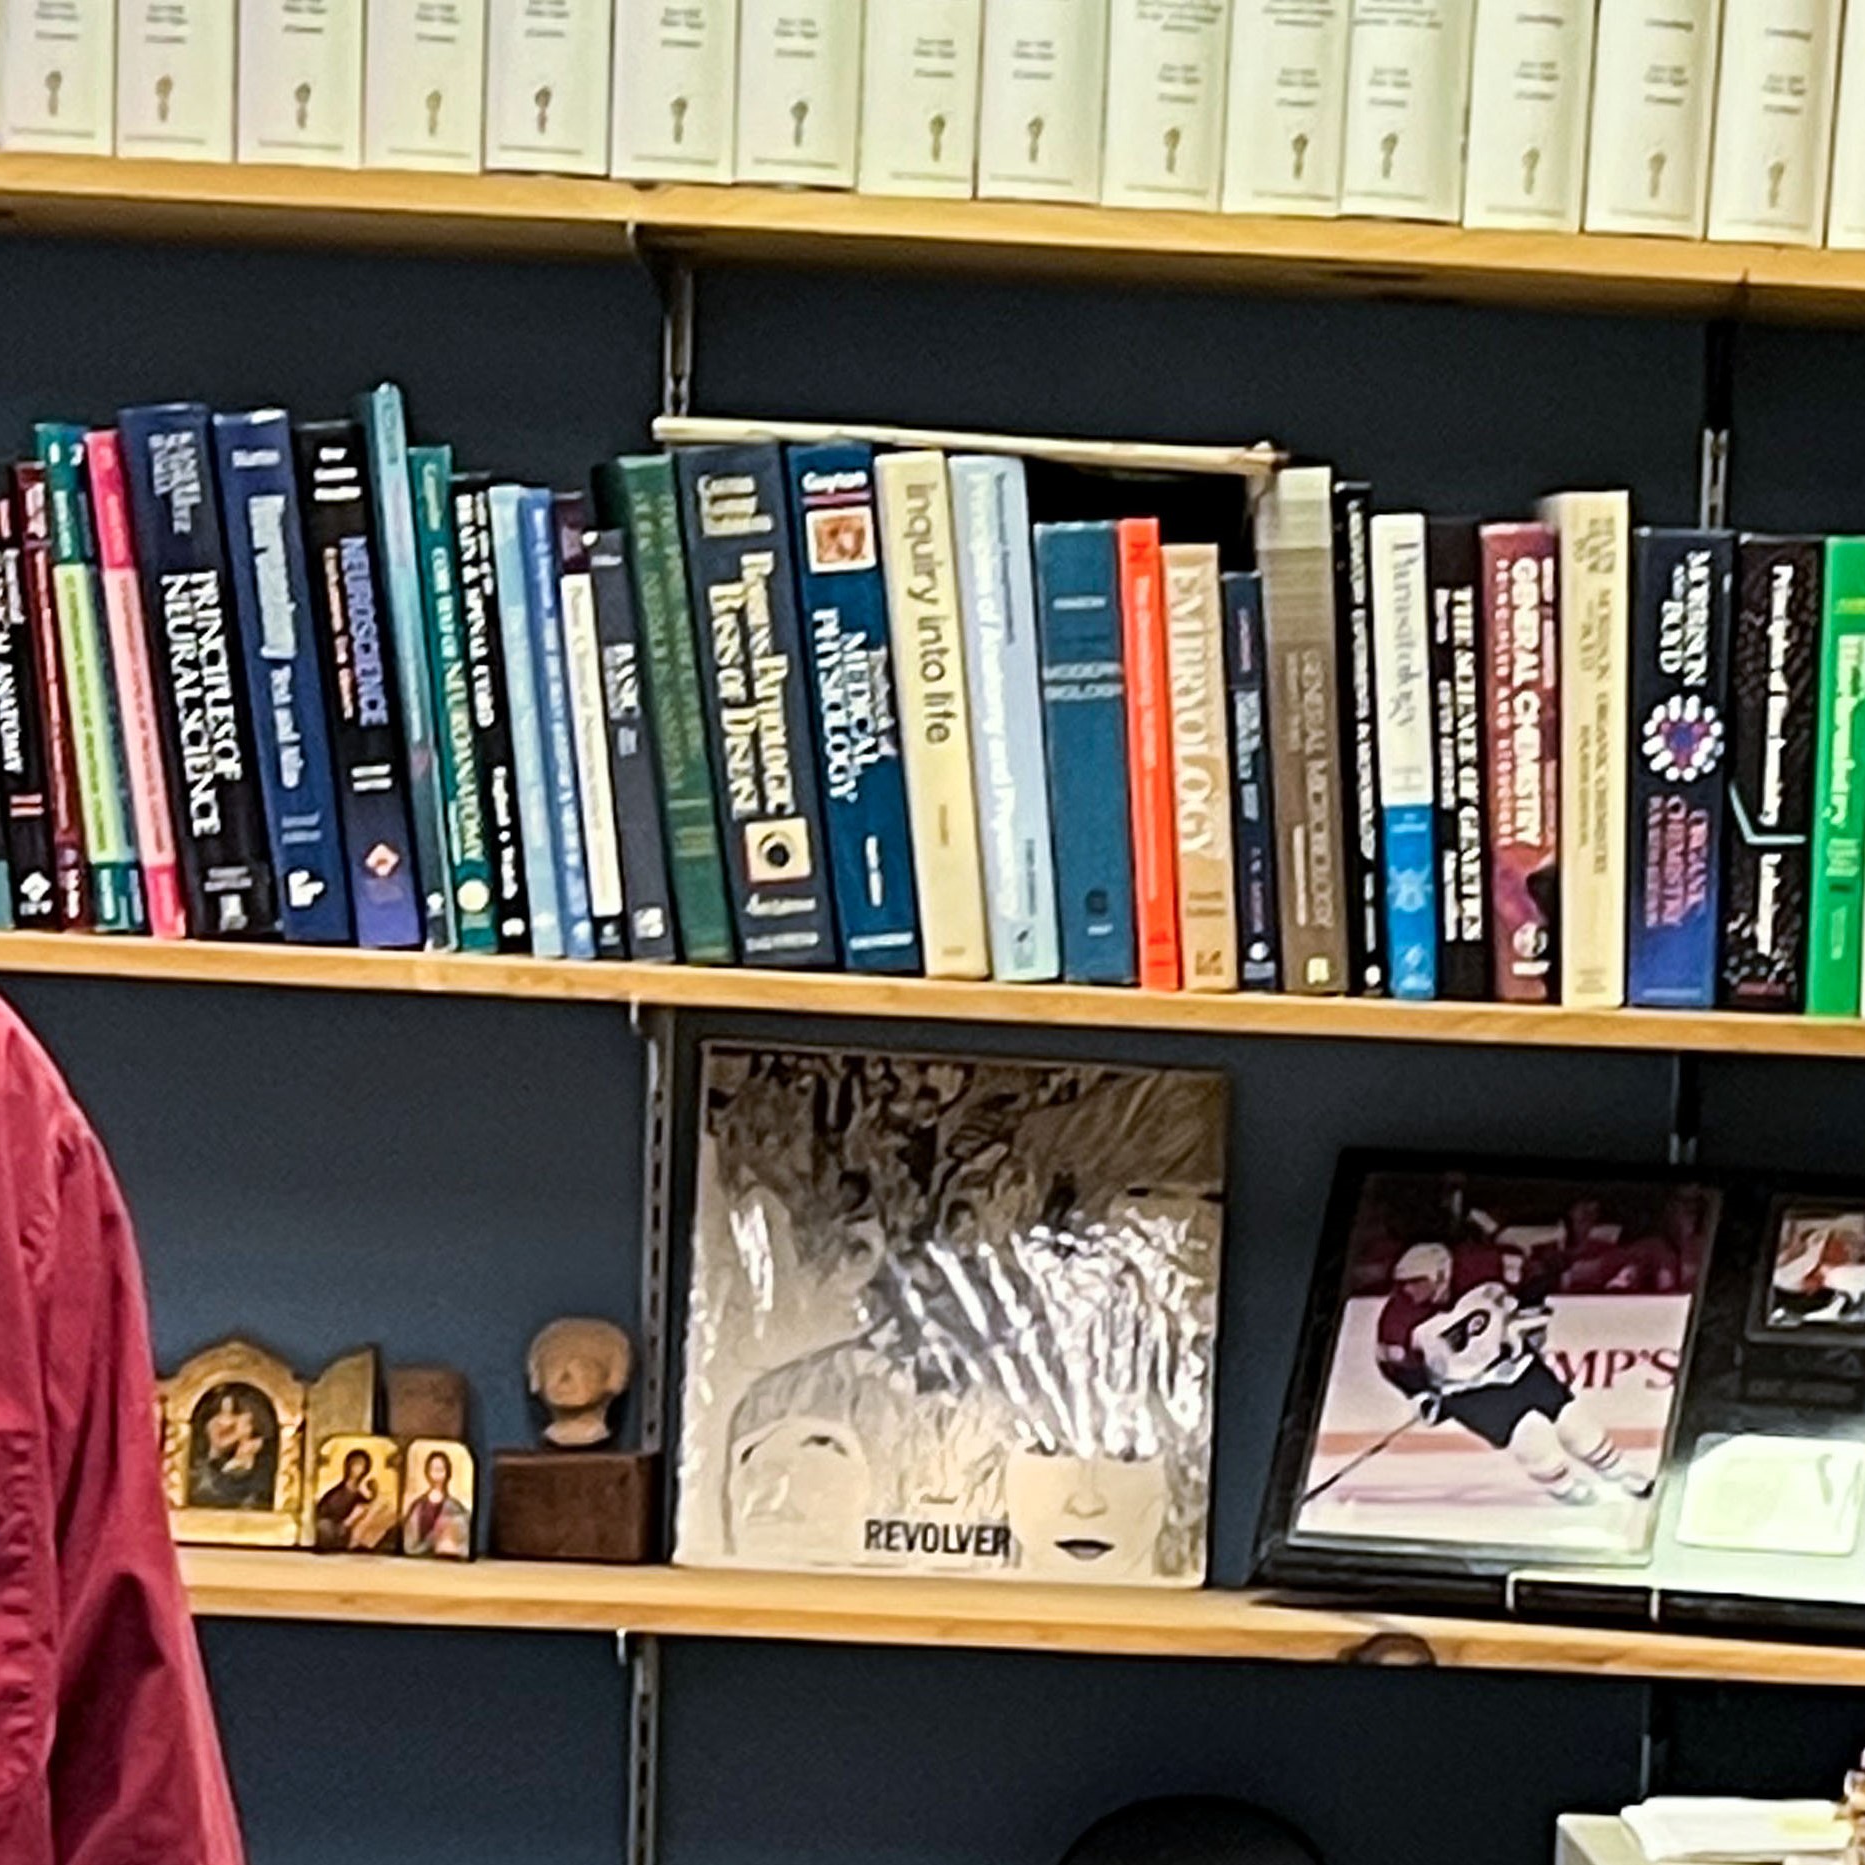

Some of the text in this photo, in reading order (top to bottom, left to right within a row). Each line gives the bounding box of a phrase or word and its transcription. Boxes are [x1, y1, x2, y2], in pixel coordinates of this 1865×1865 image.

[160, 575, 204, 708] NEURAL
[188, 571, 243, 781] PRINCIPLES OF
[340, 537, 389, 728] NEUROSCIENCE
[916, 616, 951, 683] into
[1659, 601, 1685, 674] BOYD
[1683, 550, 1712, 687] MORRISON
[444, 660, 485, 861] NEUROANATOMY
[719, 705, 760, 821] DISEASE
[812, 608, 859, 803] PHYSIOLOGY
[840, 631, 881, 765] MEDICAL
[923, 691, 958, 745] life
[1167, 566, 1215, 856] EMBRYOLOGY
[1452, 586, 1483, 942] THE SCIENCE OF GENETICS
[1510, 557, 1542, 846] GENERAL CHEMISTRY
[177, 707, 222, 837] SCIENCE
[1662, 794, 1689, 927] CHEMISTRY
[864, 1519, 1012, 1559] REVOLVER
